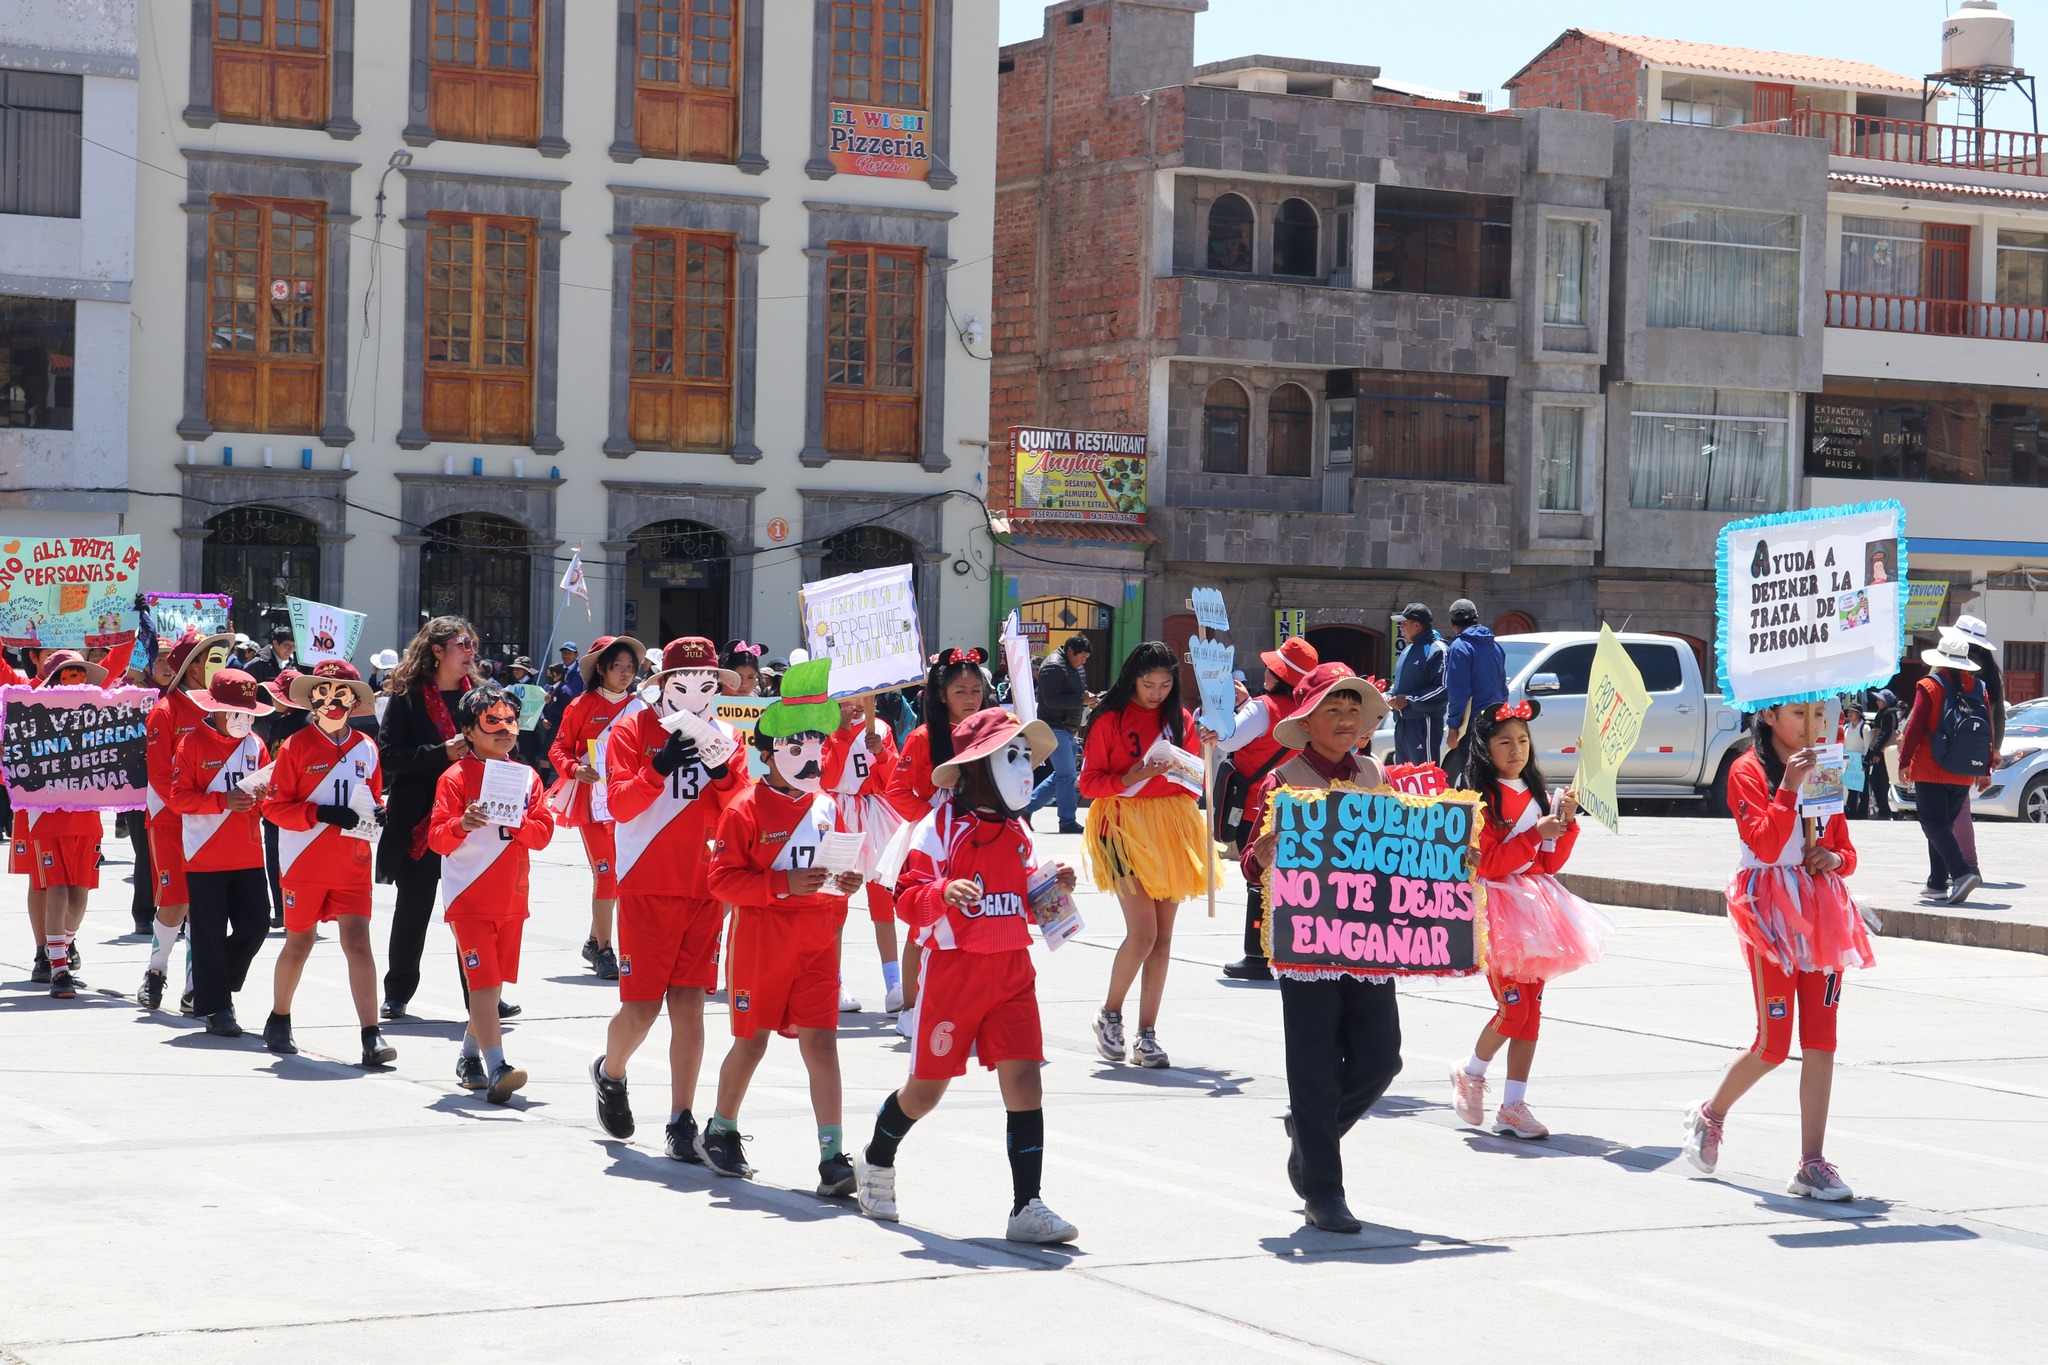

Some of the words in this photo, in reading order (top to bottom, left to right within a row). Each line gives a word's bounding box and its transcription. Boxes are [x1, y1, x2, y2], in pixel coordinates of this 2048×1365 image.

[832, 108, 857, 126] EL
[863, 111, 924, 132] WICHI
[829, 126, 929, 160] Pizzeria
[855, 155, 912, 175] Restobar
[1019, 430, 1071, 452] QUINTA
[1075, 433, 1146, 455] RESTAURANT
[1882, 433, 1924, 446] DENTAL
[1008, 431, 1016, 515] RESTAURANT
[1825, 460, 1854, 470] RAYOS
[1064, 479, 1097, 489] DESAYUNO
[1064, 489, 1098, 498] ALMUERZO
[1064, 500, 1080, 508] CENA
[1081, 500, 1087, 508] Y
[1087, 501, 1109, 509] EXTRAS
[69, 537, 116, 561] TRATA
[121, 545, 141, 571] DE
[1750, 539, 1816, 578] AYUDA
[1824, 546, 1836, 567] A
[0, 557, 24, 590] NO
[24, 562, 115, 586] PERSONAS
[1751, 574, 1819, 605] DETENER
[1831, 570, 1853, 592] LA
[156, 615, 176, 633] NO
[292, 602, 305, 630] DILE
[830, 607, 904, 646] PERSONAS
[1750, 602, 1801, 630] TRATA
[1816, 596, 1837, 619] DE
[312, 635, 335, 652] NO
[1020, 624, 1048, 634] UINTA
[1749, 622, 1830, 655] PERSONAS
[4, 718, 37, 742] TU
[49, 708, 113, 732] VIDA
[2, 743, 24, 763] ES
[30, 736, 73, 757] UNA
[1128, 731, 1142, 758] 3
[5, 763, 31, 781] NO
[39, 758, 61, 776] TE
[70, 747, 119, 771] DEJES
[853, 753, 869, 778] 6
[45, 766, 130, 795] ENGAÑAR
[333, 778, 349, 807] 11
[671, 766, 700, 801] 13
[1275, 792, 1327, 831] TU
[1337, 793, 1467, 844] CUERPO
[768, 830, 788, 839] sport
[790, 845, 816, 869] 17
[1276, 830, 1325, 870] ES
[1330, 832, 1472, 882] SAGRADO
[1273, 869, 1321, 909] NO
[1328, 871, 1377, 913] TE
[1389, 875, 1474, 922] DEJES
[1291, 913, 1451, 967] ENGAÑAR
[930, 1021, 956, 1057] 6
